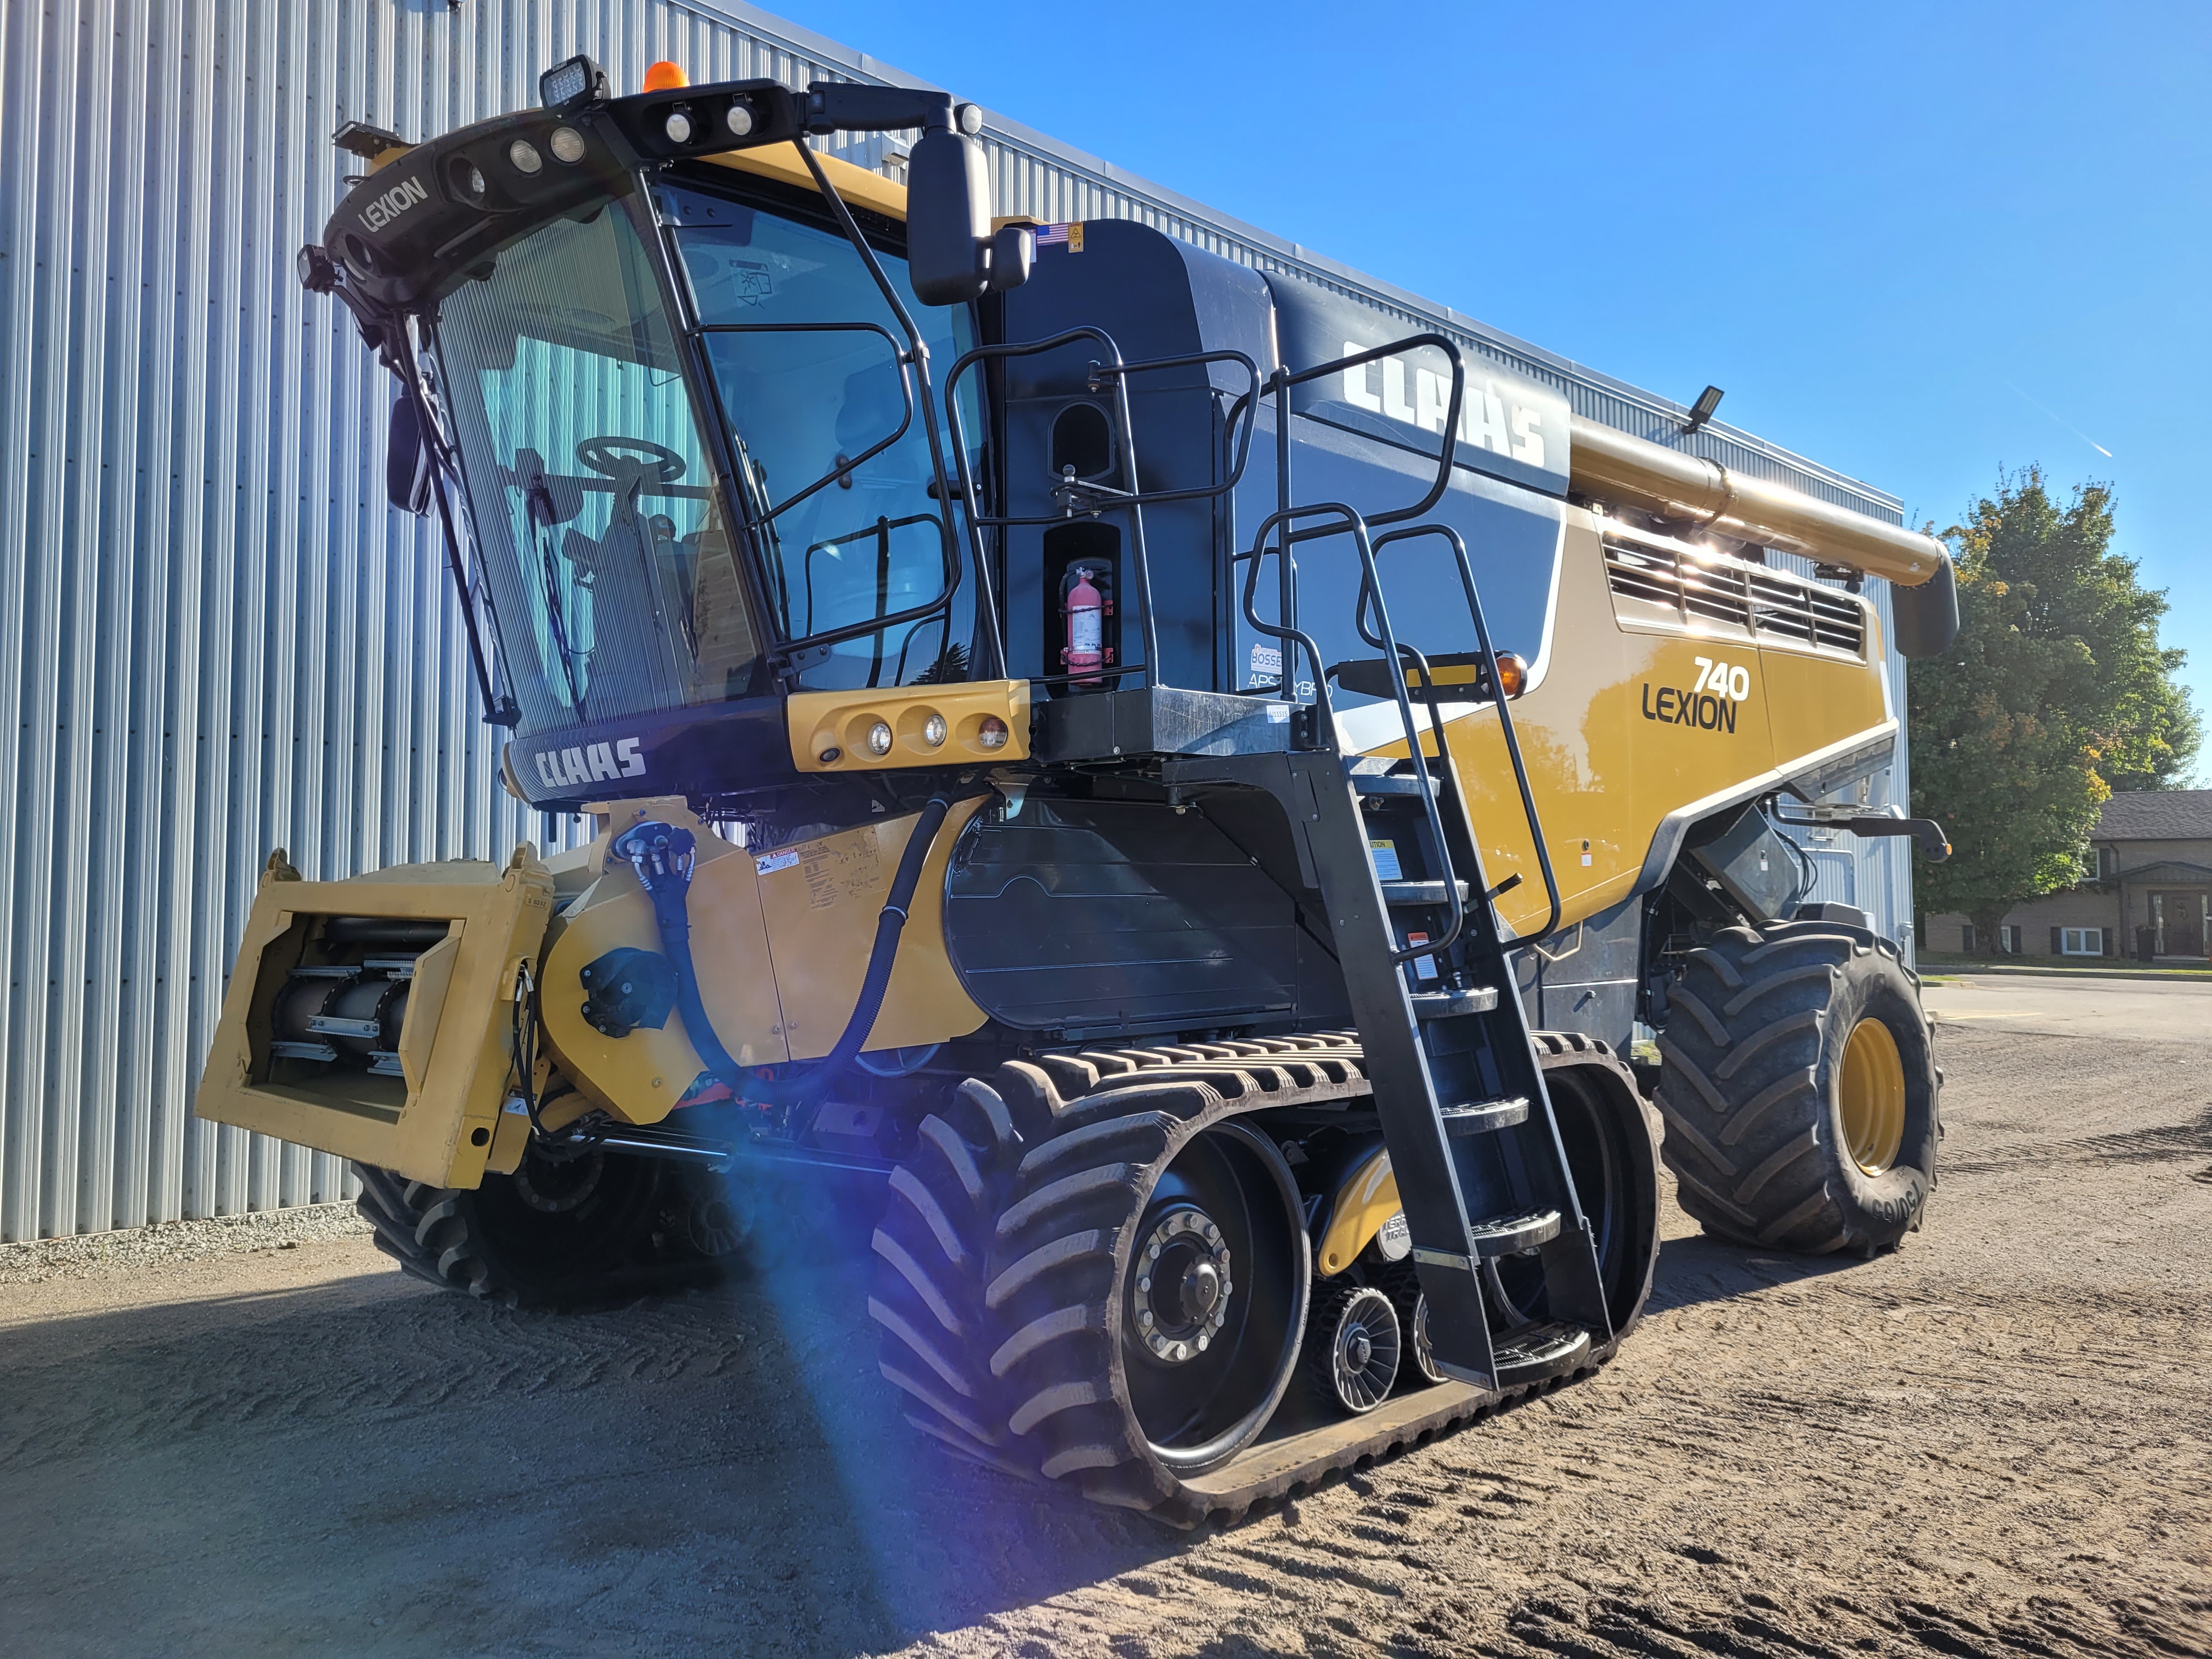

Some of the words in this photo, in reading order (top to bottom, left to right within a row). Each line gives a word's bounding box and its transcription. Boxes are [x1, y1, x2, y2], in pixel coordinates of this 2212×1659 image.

[358, 176, 428, 233] LEXION
[1344, 341, 1545, 467] CLAAS
[1693, 656, 1750, 702] 740
[1642, 682, 1737, 734] LEXION
[535, 737, 647, 787] CLAAS
[777, 848, 795, 857] DANGER
